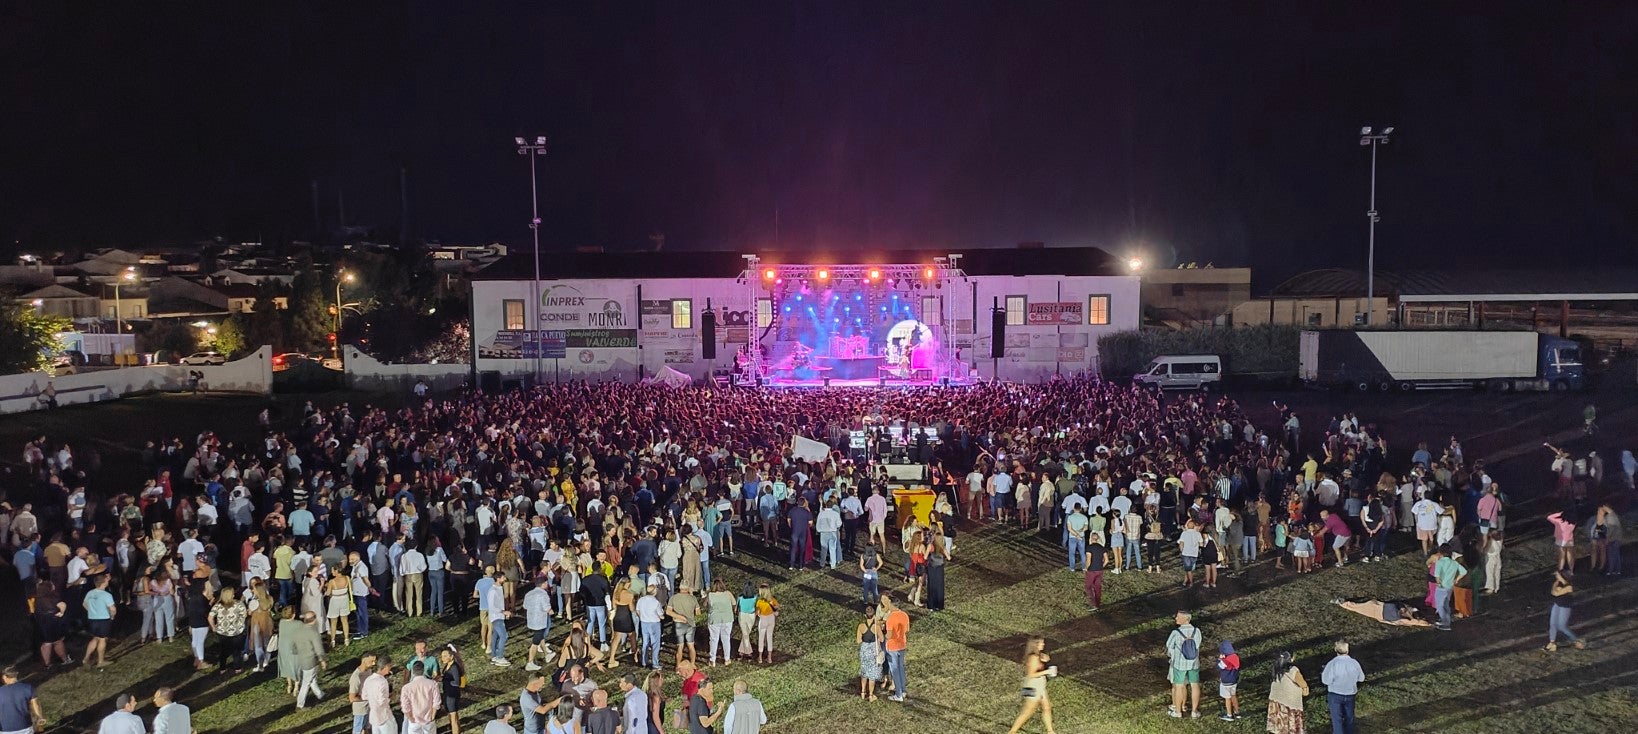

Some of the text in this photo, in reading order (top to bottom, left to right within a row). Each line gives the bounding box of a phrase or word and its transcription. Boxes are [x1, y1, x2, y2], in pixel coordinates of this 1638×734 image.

[547, 297, 585, 306] INPREX
[1029, 303, 1082, 313] Lusitania
[540, 313, 580, 321] CONDE
[589, 313, 627, 326] MONRI
[1029, 312, 1053, 321] Cars
[566, 330, 610, 338] Suministros
[586, 337, 636, 347] VALVERDE
